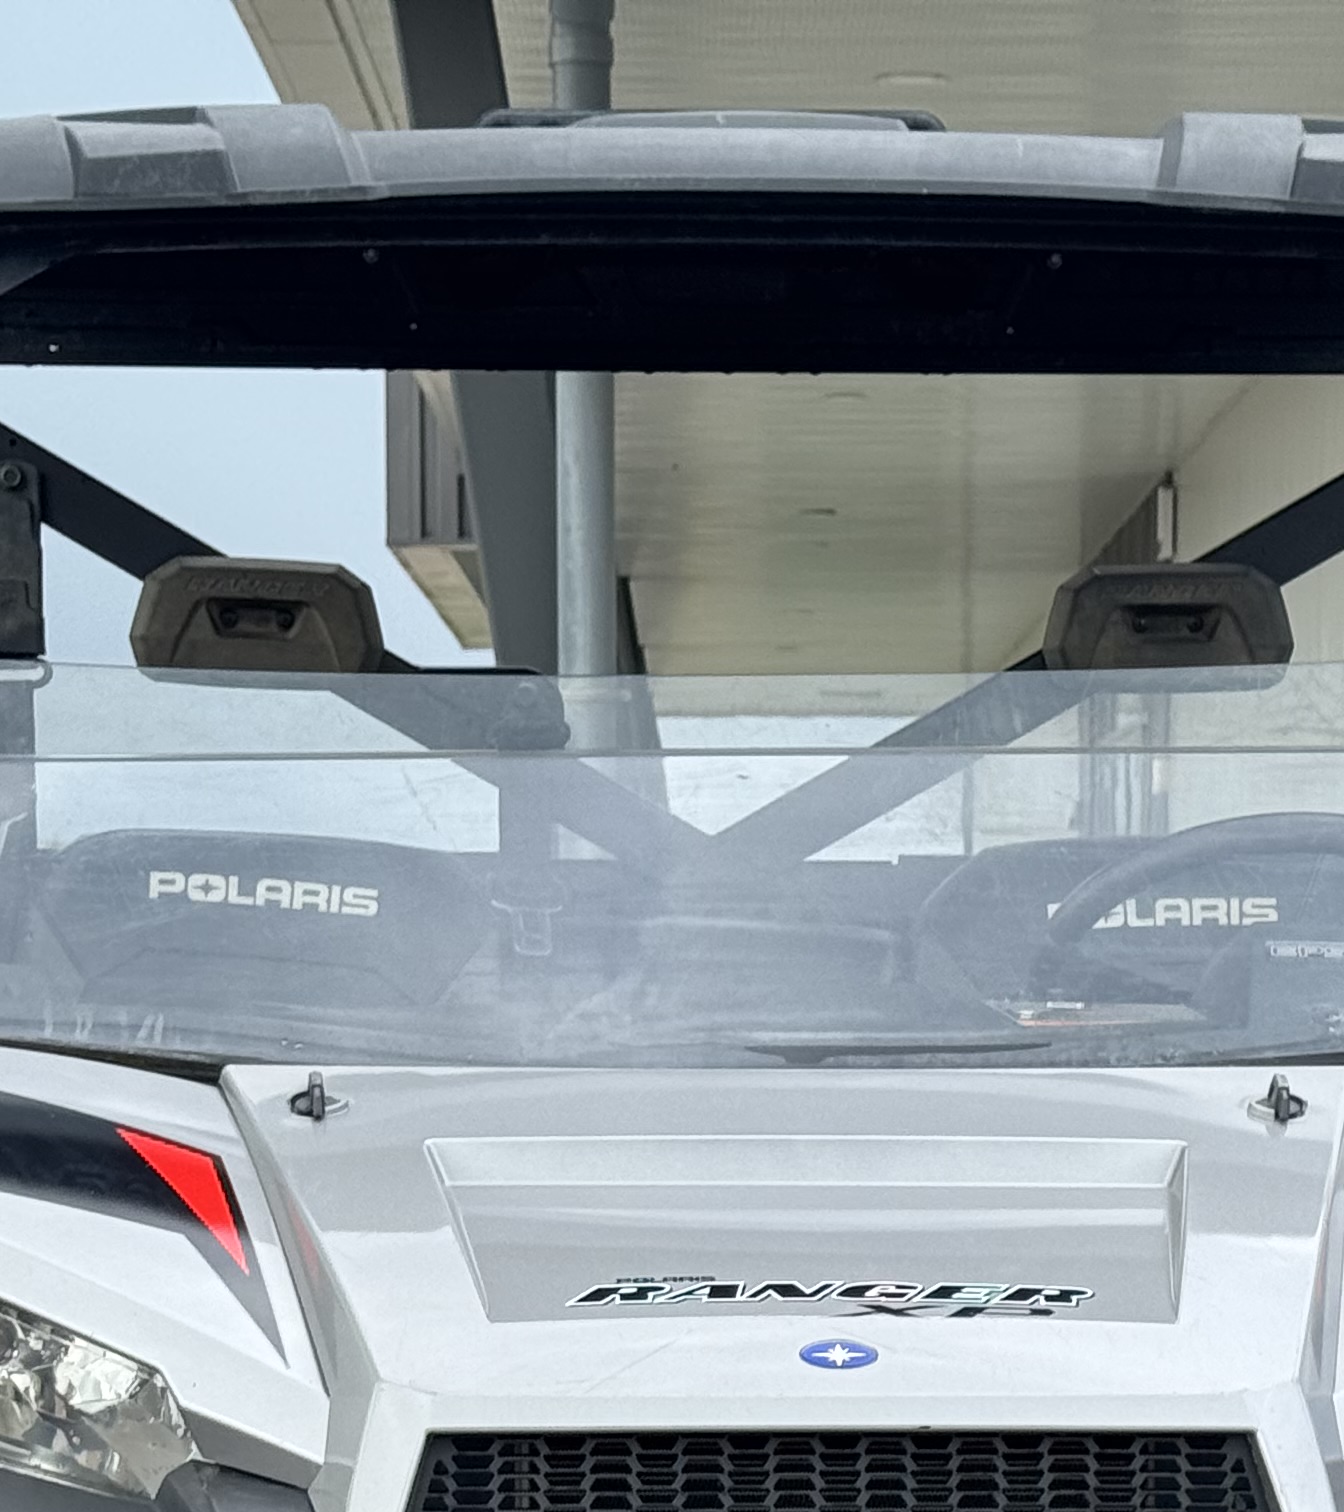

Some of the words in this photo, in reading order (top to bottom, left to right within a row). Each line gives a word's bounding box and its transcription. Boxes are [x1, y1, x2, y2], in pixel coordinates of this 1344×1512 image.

[149, 870, 379, 917] POLARIS
[565, 1280, 1095, 1307] RANGER
[830, 1304, 1055, 1318] XP
